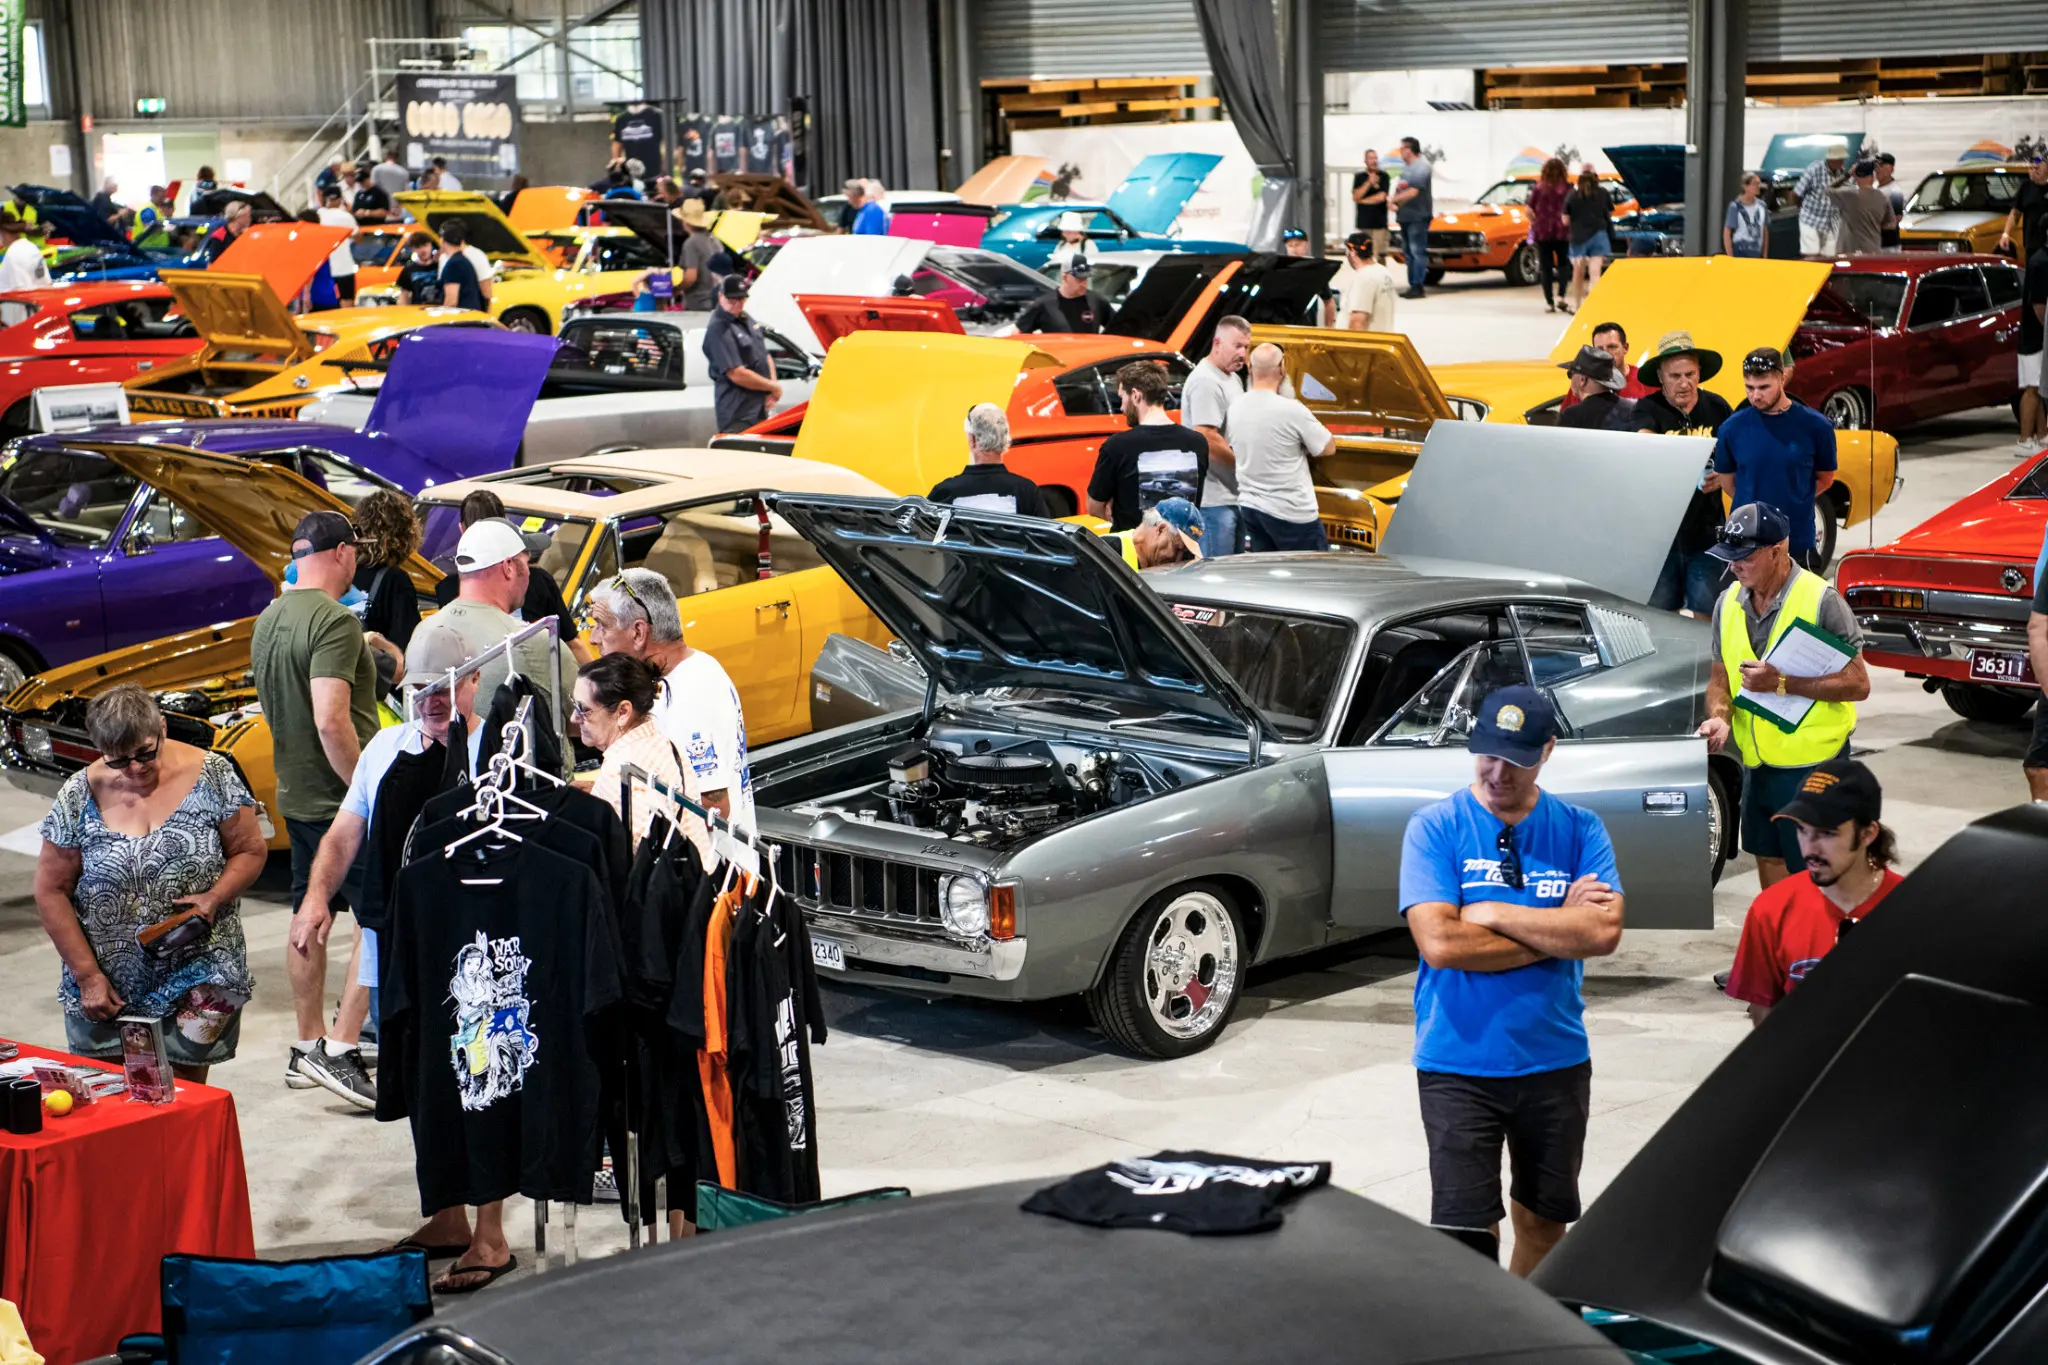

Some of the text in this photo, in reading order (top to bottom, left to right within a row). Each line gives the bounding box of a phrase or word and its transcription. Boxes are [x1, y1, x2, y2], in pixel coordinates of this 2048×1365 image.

[1976, 656, 2023, 676] 36311
[1536, 879, 1567, 898] 60
[489, 936, 521, 958] WAR
[813, 942, 840, 963] 2340
